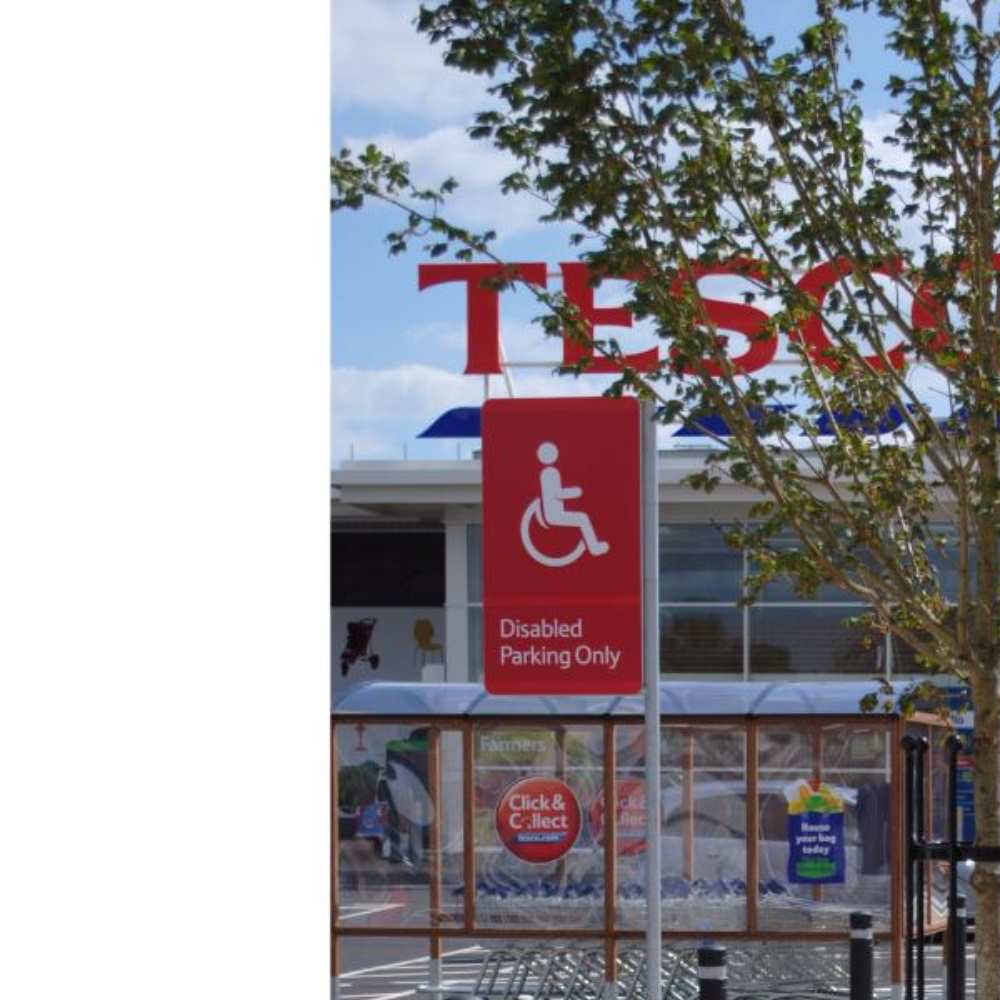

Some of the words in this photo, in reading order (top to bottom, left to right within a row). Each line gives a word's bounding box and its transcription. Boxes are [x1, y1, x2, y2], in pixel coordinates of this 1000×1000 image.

[500, 618, 583, 638] Disabled
[500, 646, 571, 669] Parking
[575, 645, 621, 670] Only
[508, 793, 550, 812] Click
[551, 793, 566, 811] &
[802, 845, 830, 856] today
